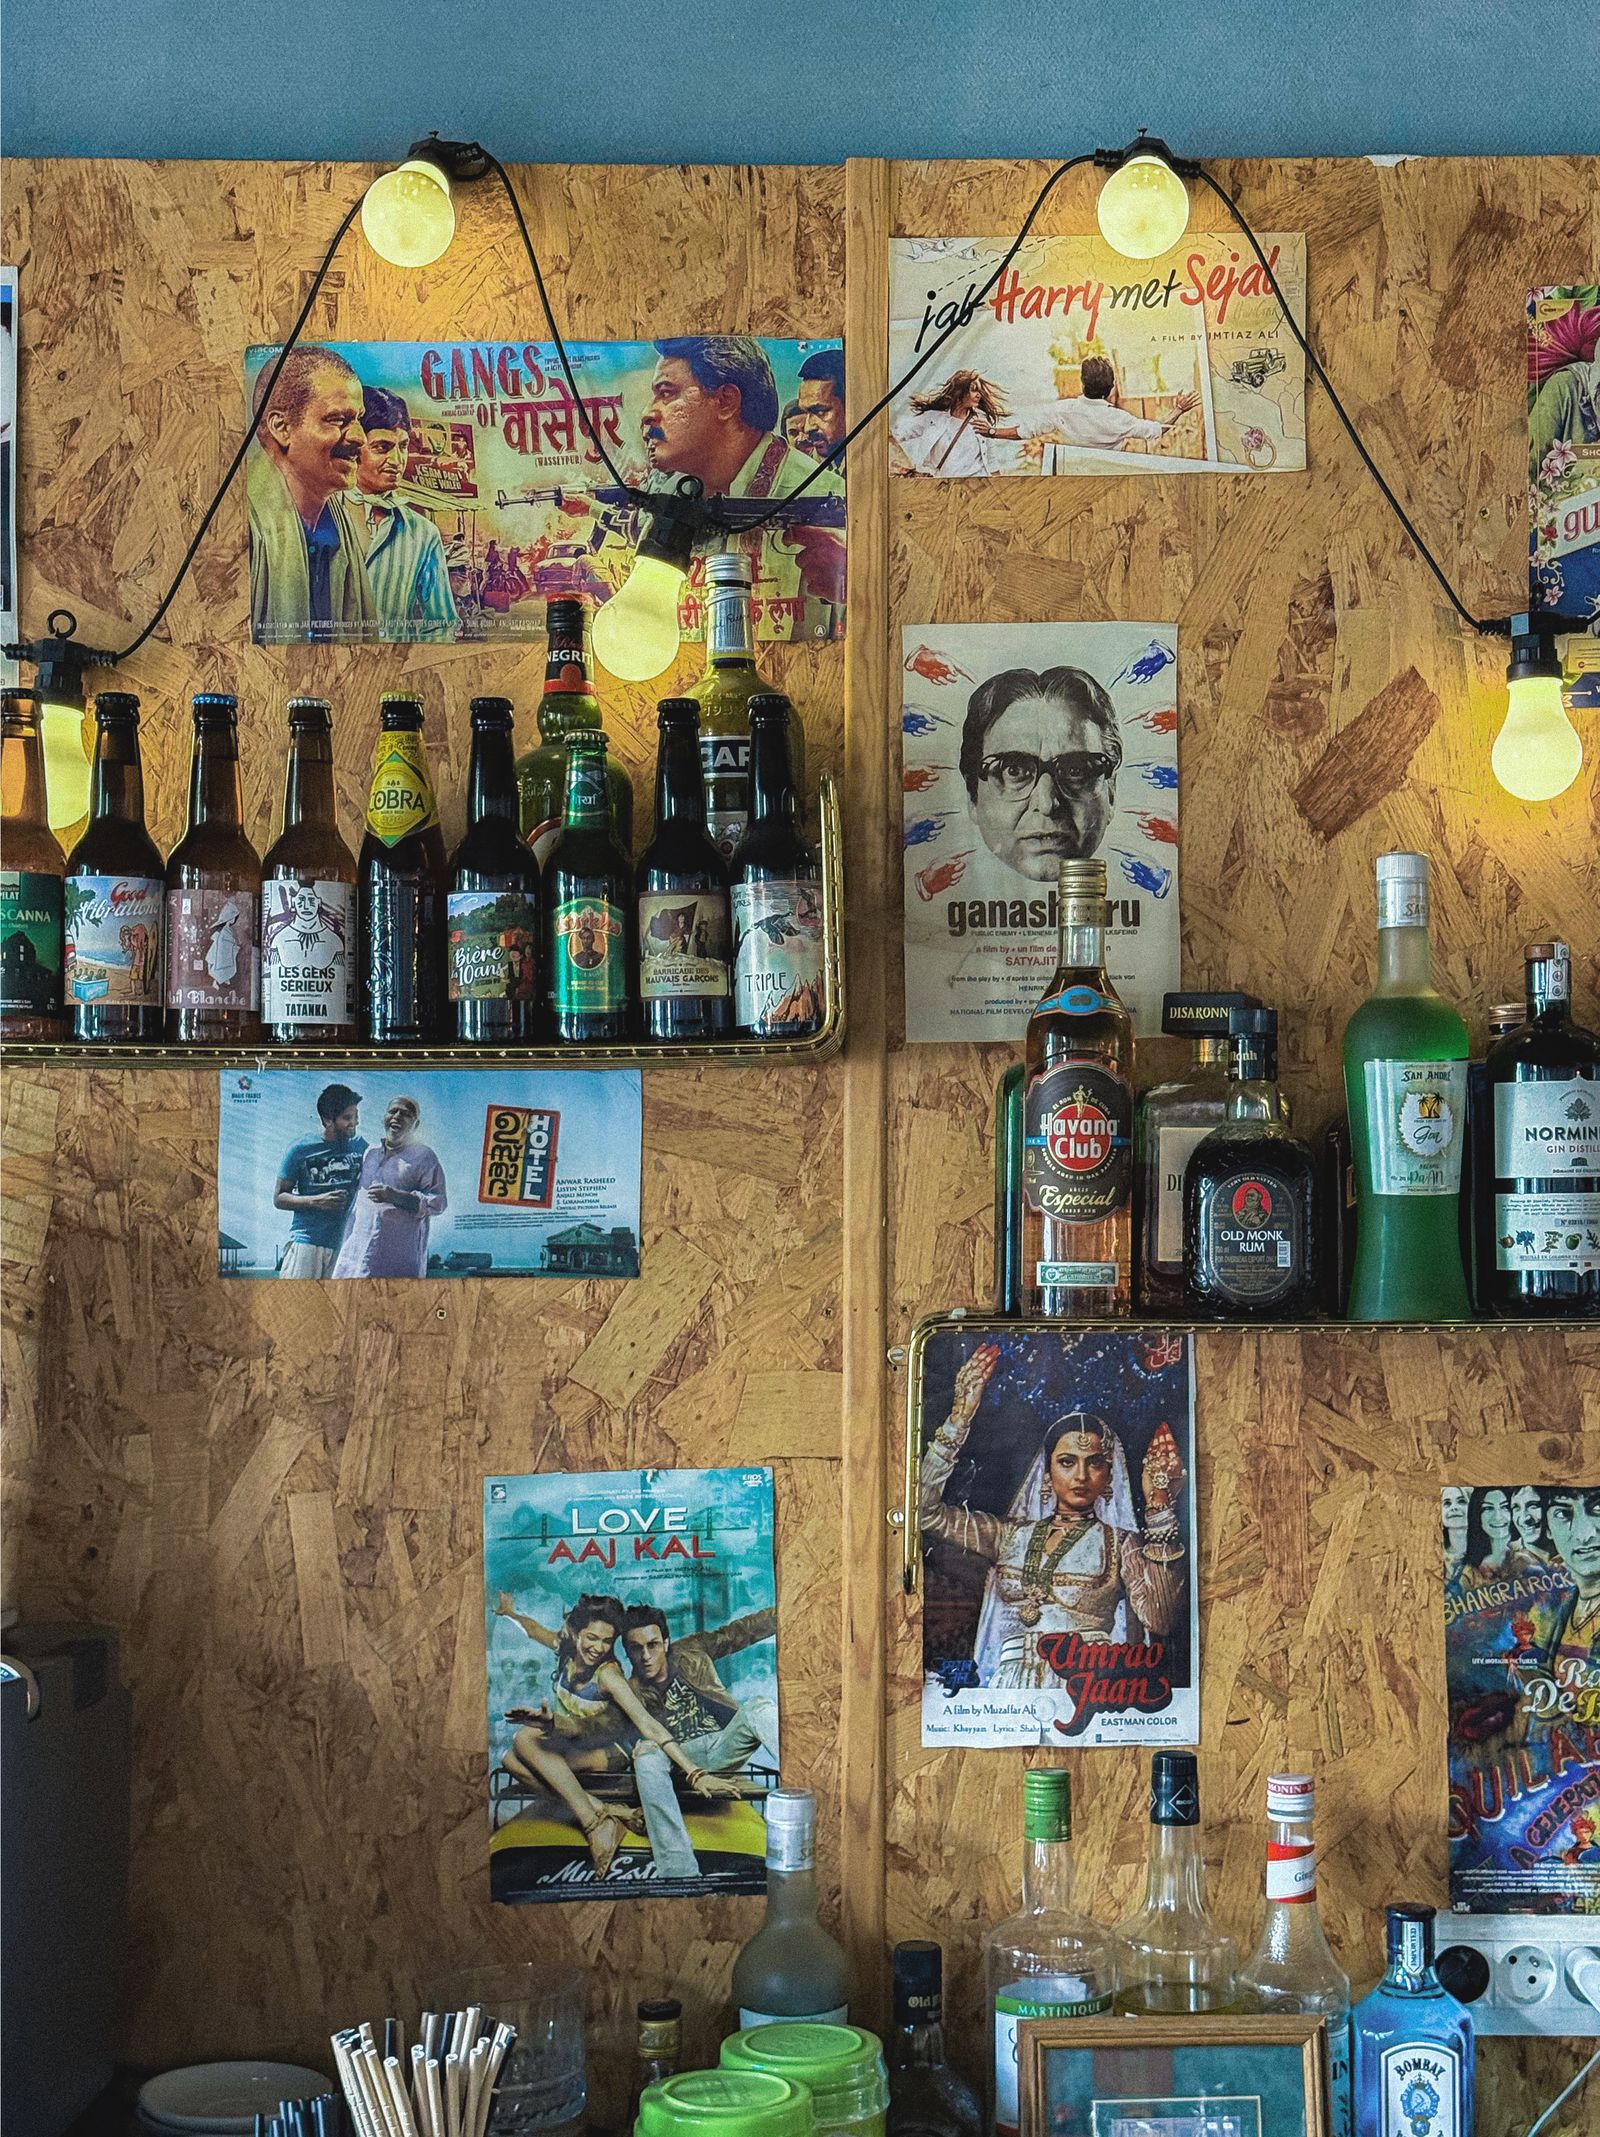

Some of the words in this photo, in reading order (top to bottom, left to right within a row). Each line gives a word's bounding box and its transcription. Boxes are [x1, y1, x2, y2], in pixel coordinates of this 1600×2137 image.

[989, 266, 1104, 341] Harry
[1108, 269, 1183, 310] met
[1180, 245, 1280, 324] Sejal
[1208, 331, 1252, 340] IMTIAZ
[1258, 331, 1279, 339] ALI
[420, 345, 546, 402] GANGS
[476, 402, 499, 429] OF
[110, 881, 149, 907] Good
[948, 890, 1141, 937] ganashru
[454, 945, 504, 967] Bière
[983, 945, 998, 953] film
[1000, 945, 1009, 954] by
[1029, 945, 1045, 953] film
[1046, 945, 1057, 953] de
[278, 966, 300, 979] LES
[302, 967, 336, 979] GENS
[1005, 956, 1057, 967] SATYAJIT
[280, 979, 333, 992] SÉRIEUX
[683, 974, 719, 984] GARÇONS
[744, 972, 787, 992] TRIPLE
[186, 989, 246, 1006] Blanche
[1169, 1006, 1229, 1019] DISARONN
[1040, 1112, 1118, 1136] Havana
[1525, 1126, 1600, 1141] NORMIN
[523, 1114, 550, 1201] HOTEL
[1054, 1137, 1102, 1159] Club
[1546, 1145, 1565, 1153] GIN
[1039, 1184, 1116, 1214] Especial
[1221, 1230, 1244, 1241] OLD
[1247, 1230, 1284, 1241] MONK
[1239, 1241, 1265, 1253] RUM
[571, 1506, 689, 1535] LOVE
[548, 1537, 616, 1569] AAJ
[633, 1535, 716, 1561] KAL
[1444, 1580, 1528, 1626] BHANGRA
[1527, 1571, 1576, 1594] ROCK
[1036, 1632, 1164, 1670] Umrao
[1054, 1671, 1171, 1732] Jaan
[1521, 1677, 1576, 1713] De
[943, 1705, 952, 1715] A
[954, 1704, 970, 1715] film
[972, 1705, 983, 1717] by
[983, 1704, 1021, 1715] Muzaffar
[1022, 1704, 1036, 1716] Ali
[1101, 1717, 1145, 1727] EASTMAN
[1146, 1717, 1178, 1725] COLOR
[1018, 2002, 1100, 2017] MARTINIQUE
[1393, 2057, 1447, 2082] BOMBAY
